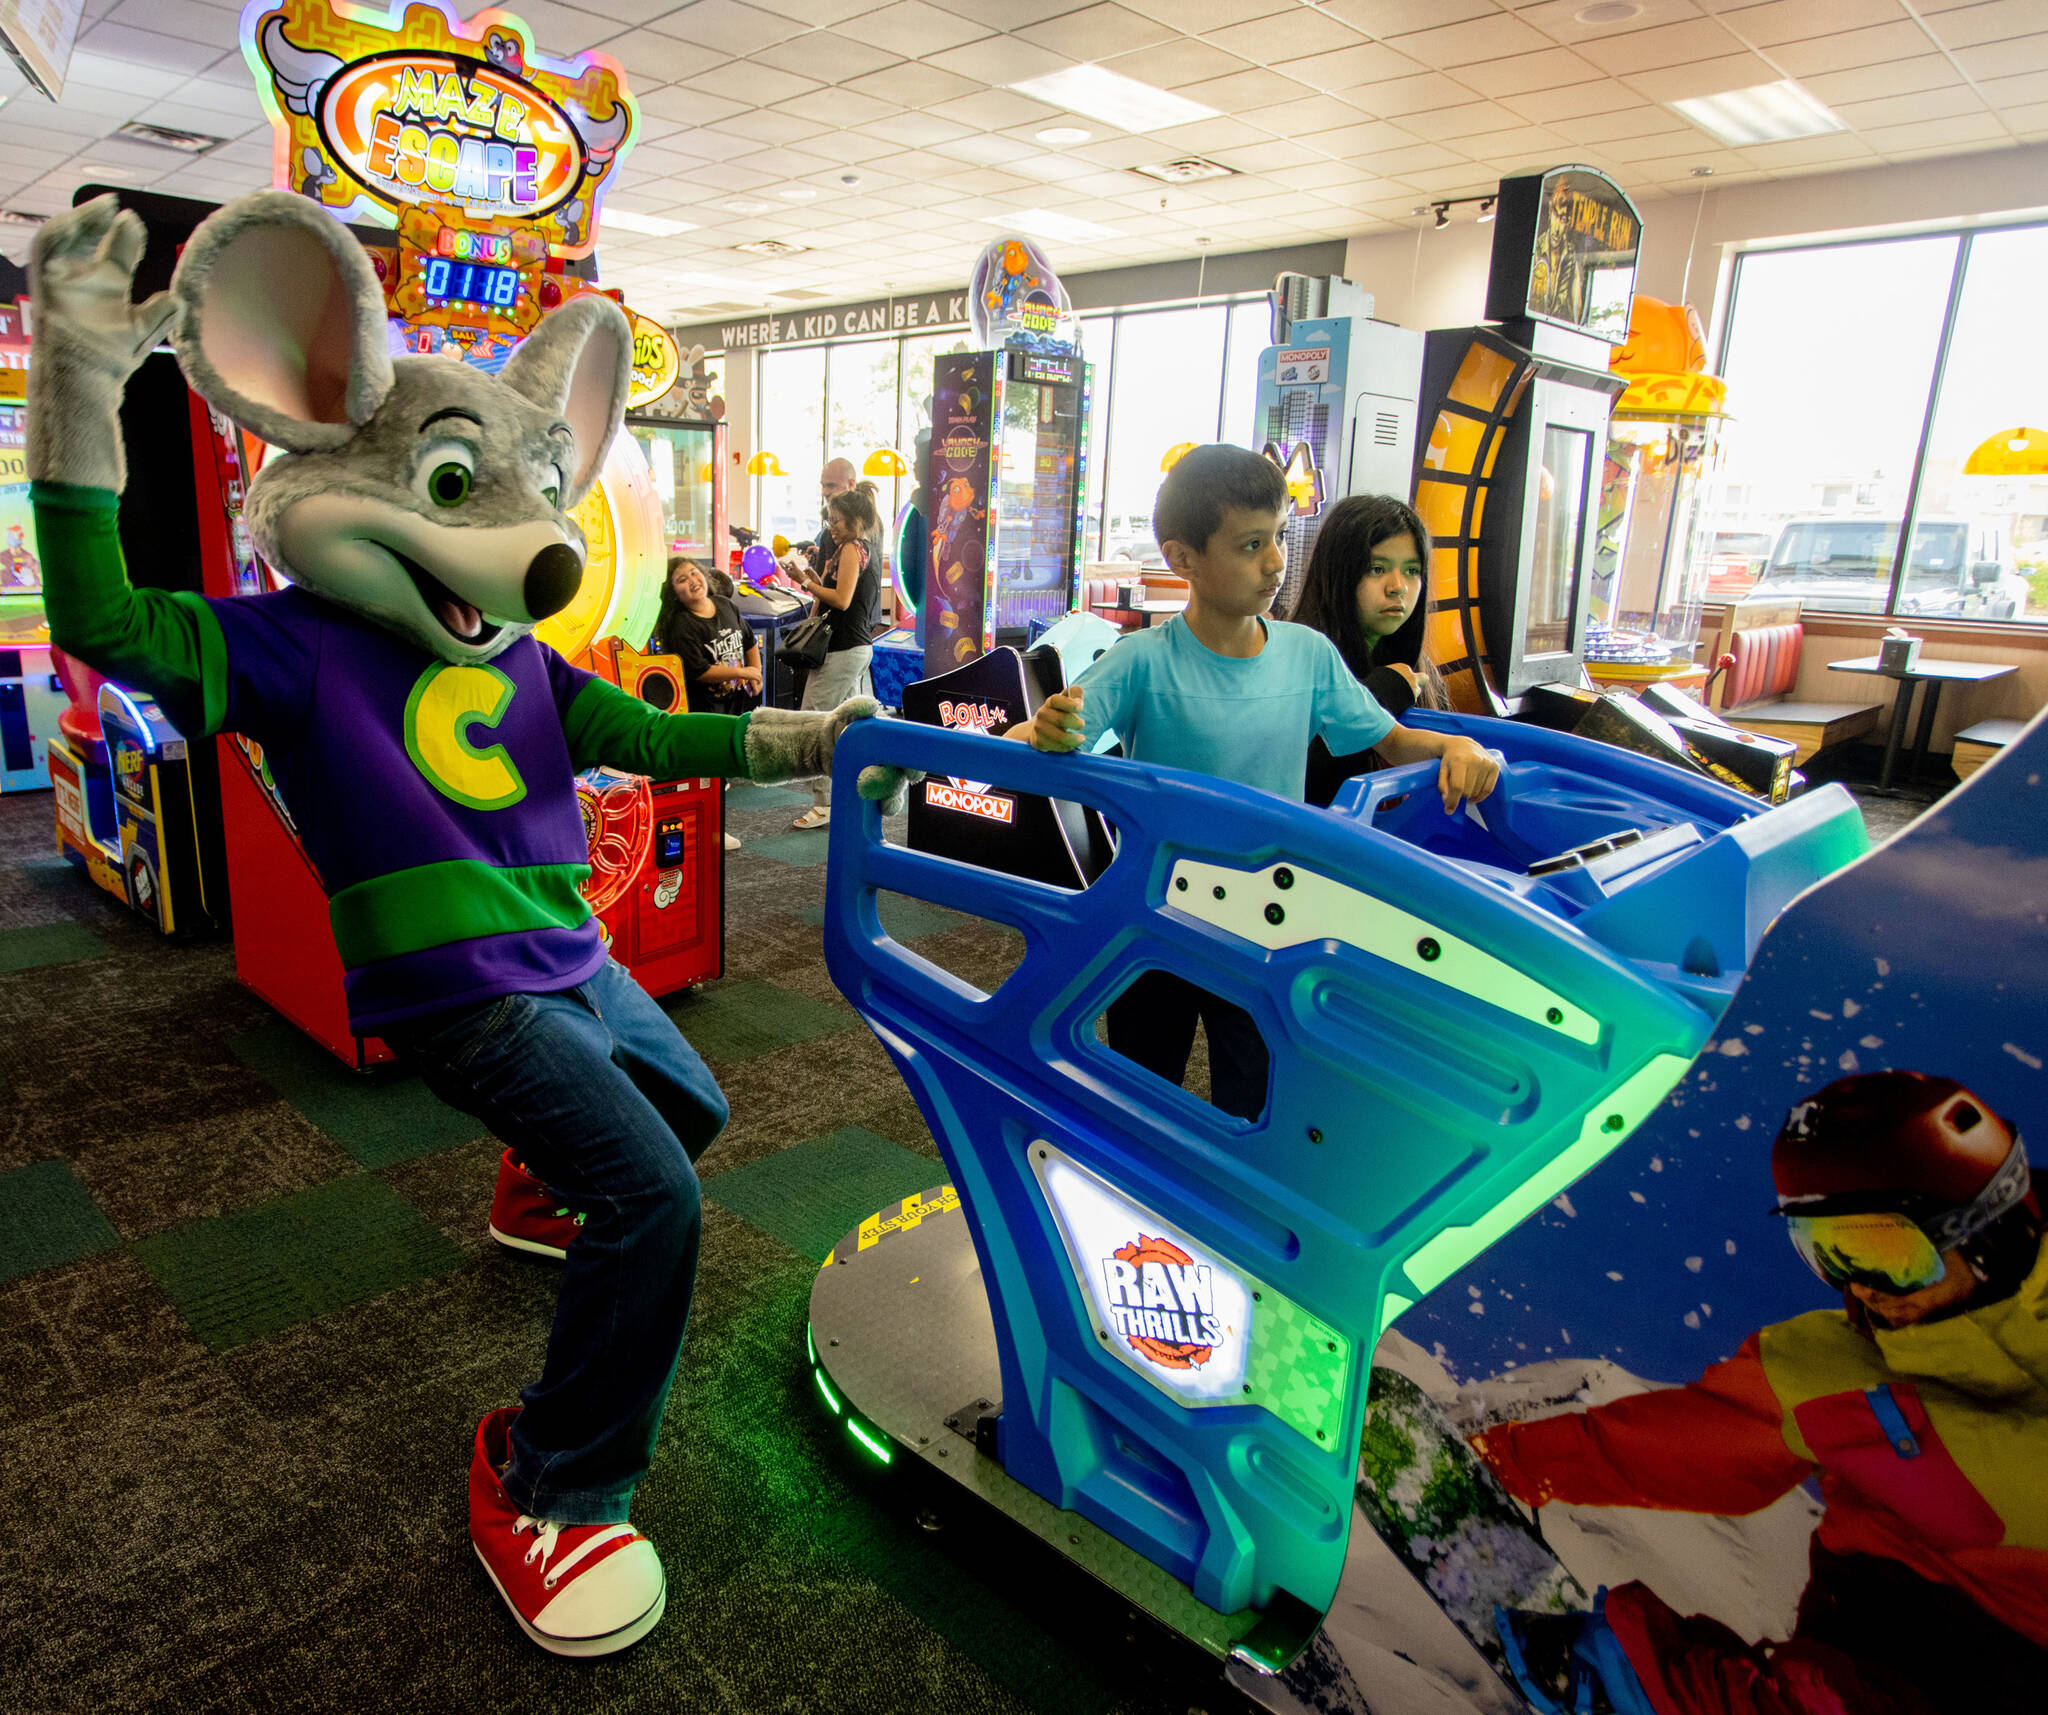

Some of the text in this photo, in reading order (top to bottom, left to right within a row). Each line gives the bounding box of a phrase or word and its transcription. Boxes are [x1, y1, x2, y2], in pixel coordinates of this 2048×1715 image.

[393, 66, 525, 142] MAZE
[366, 114, 538, 204] ESCAPE
[1570, 191, 1632, 251] TEMPLE RUN
[438, 227, 512, 265] BONUS
[426, 260, 517, 305] 0118
[451, 329, 477, 342] BALL
[721, 296, 969, 348] WHERE A KID CAN BE A KI
[1022, 312, 1057, 333] CODE
[1280, 350, 1327, 362] MONOPOLY
[946, 446, 976, 458] CODE
[938, 700, 995, 728] ROLL
[404, 660, 528, 811] C
[117, 748, 144, 775] NERF
[928, 784, 1010, 819] MONOPOLY
[861, 1220, 897, 1240] STEP
[896, 1203, 938, 1223] YOUR
[1102, 1258, 1214, 1316] RAW
[1110, 1304, 1224, 1348] THRILLS
